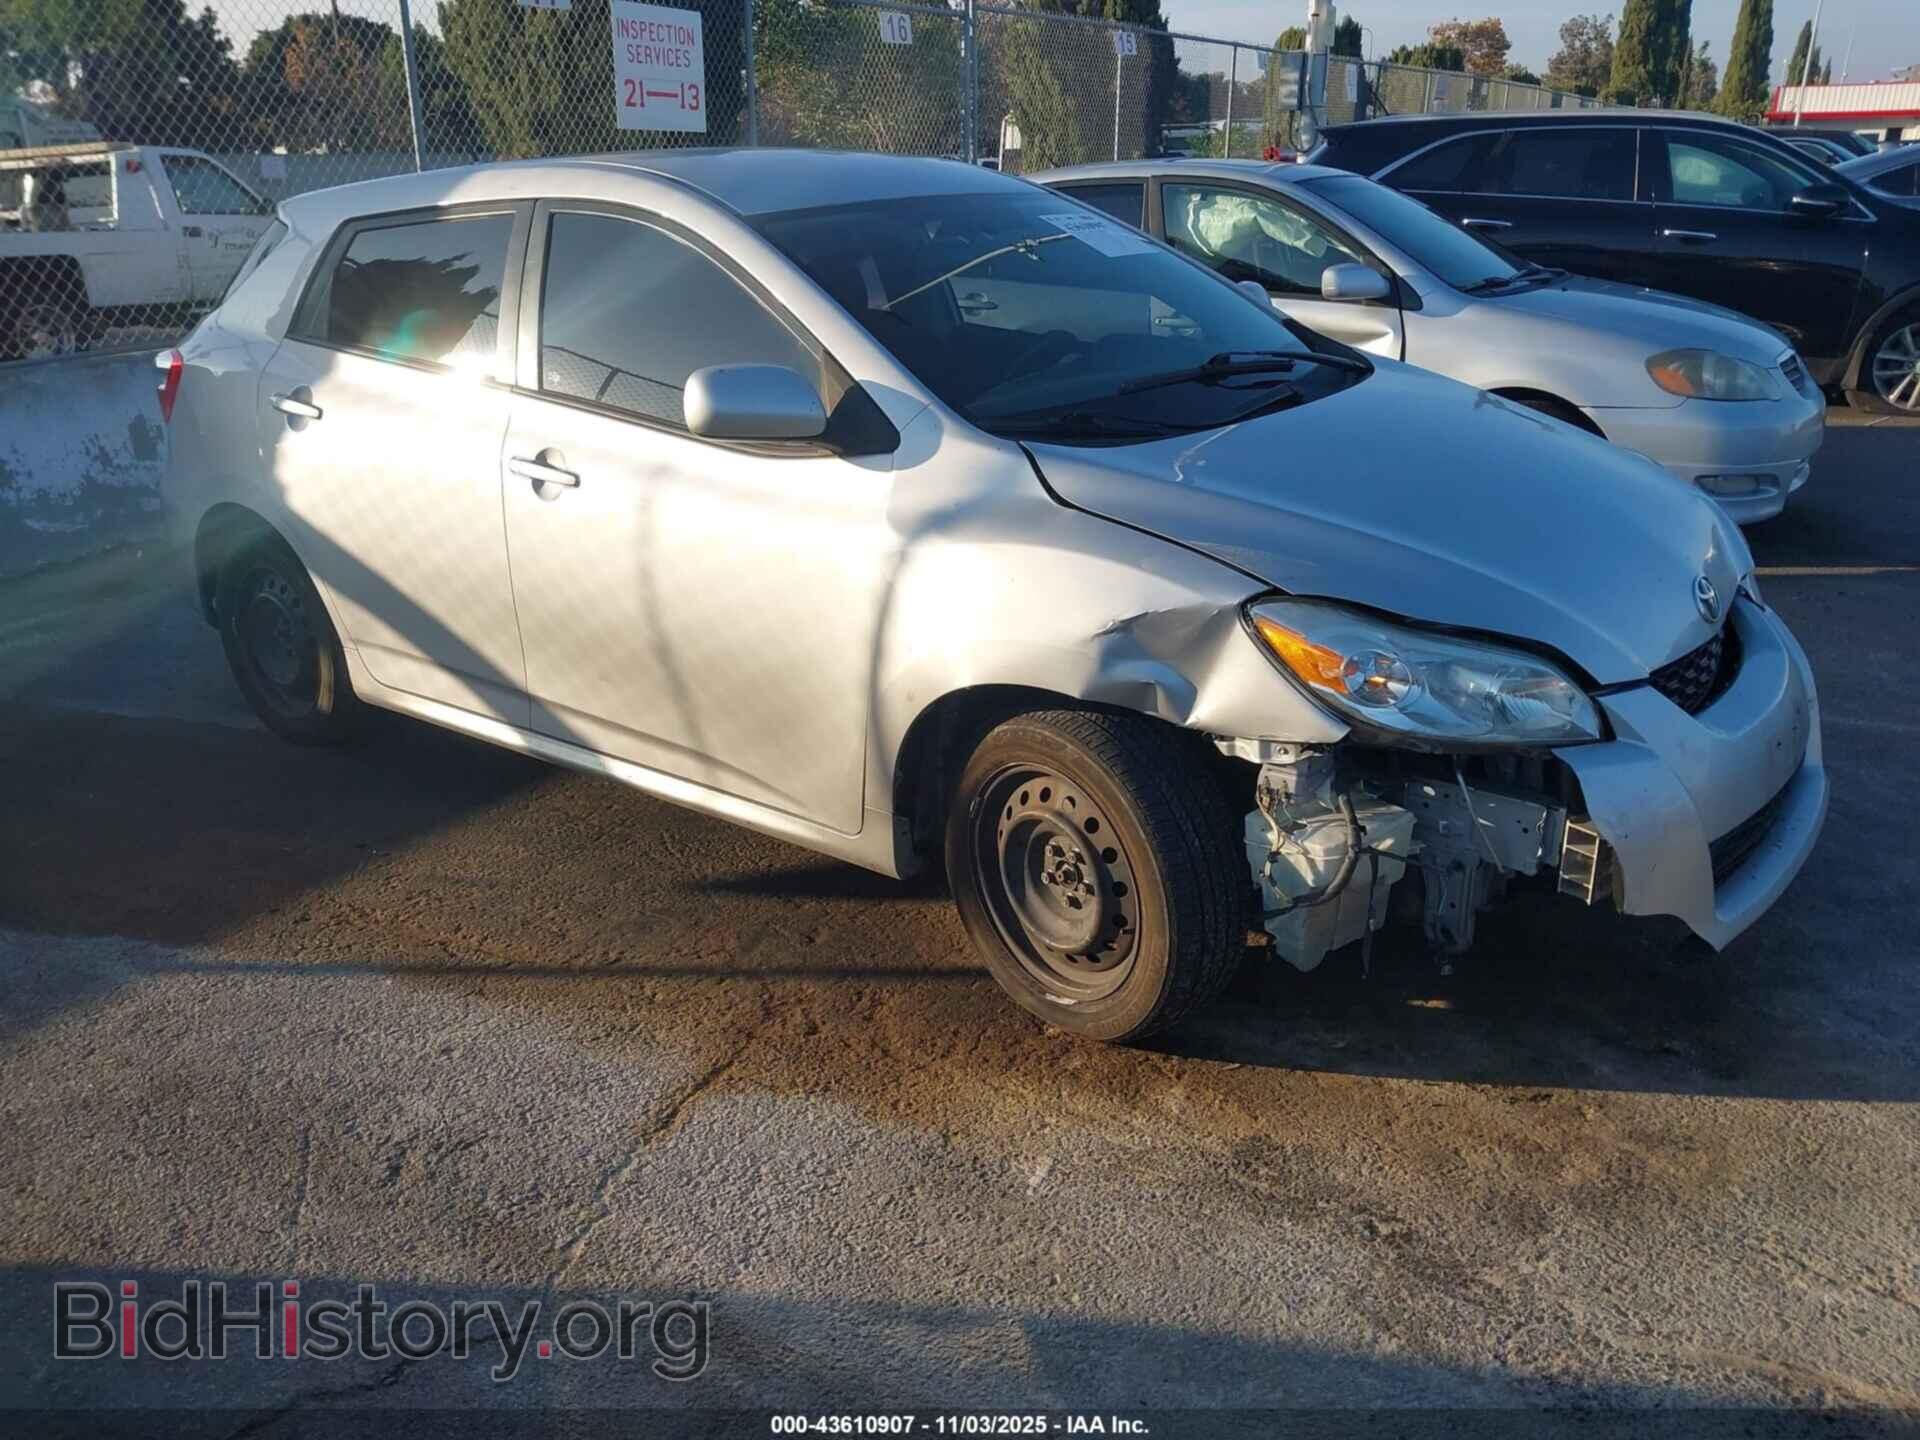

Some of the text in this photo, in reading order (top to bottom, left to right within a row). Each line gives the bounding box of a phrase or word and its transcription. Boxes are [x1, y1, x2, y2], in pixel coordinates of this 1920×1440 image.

[616, 18, 695, 46] INSPECTION
[887, 15, 907, 42] 16
[1119, 32, 1133, 53] 15
[626, 44, 691, 68] SERVICES
